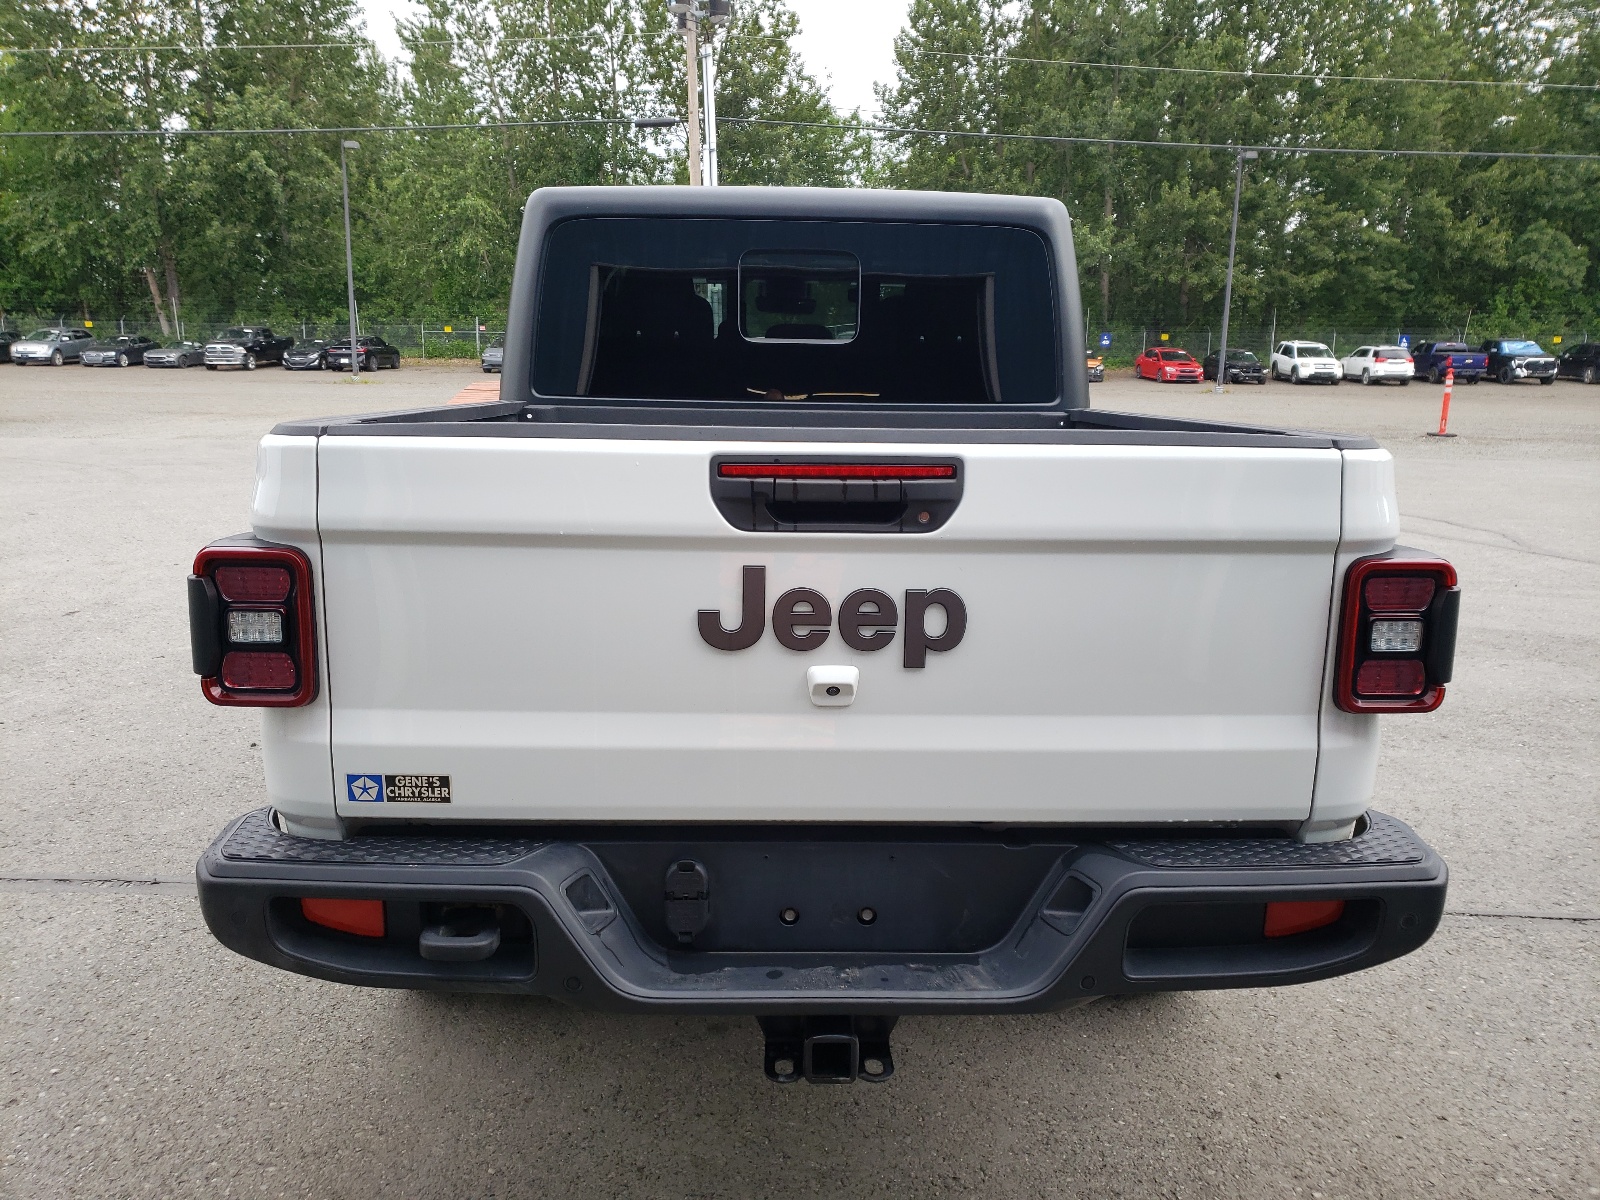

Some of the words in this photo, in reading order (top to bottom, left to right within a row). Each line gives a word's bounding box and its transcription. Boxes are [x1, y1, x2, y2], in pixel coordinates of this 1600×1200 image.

[697, 565, 967, 668] Jeep
[395, 776, 440, 786] GENE'S
[386, 786, 450, 797] CHRYSLER
